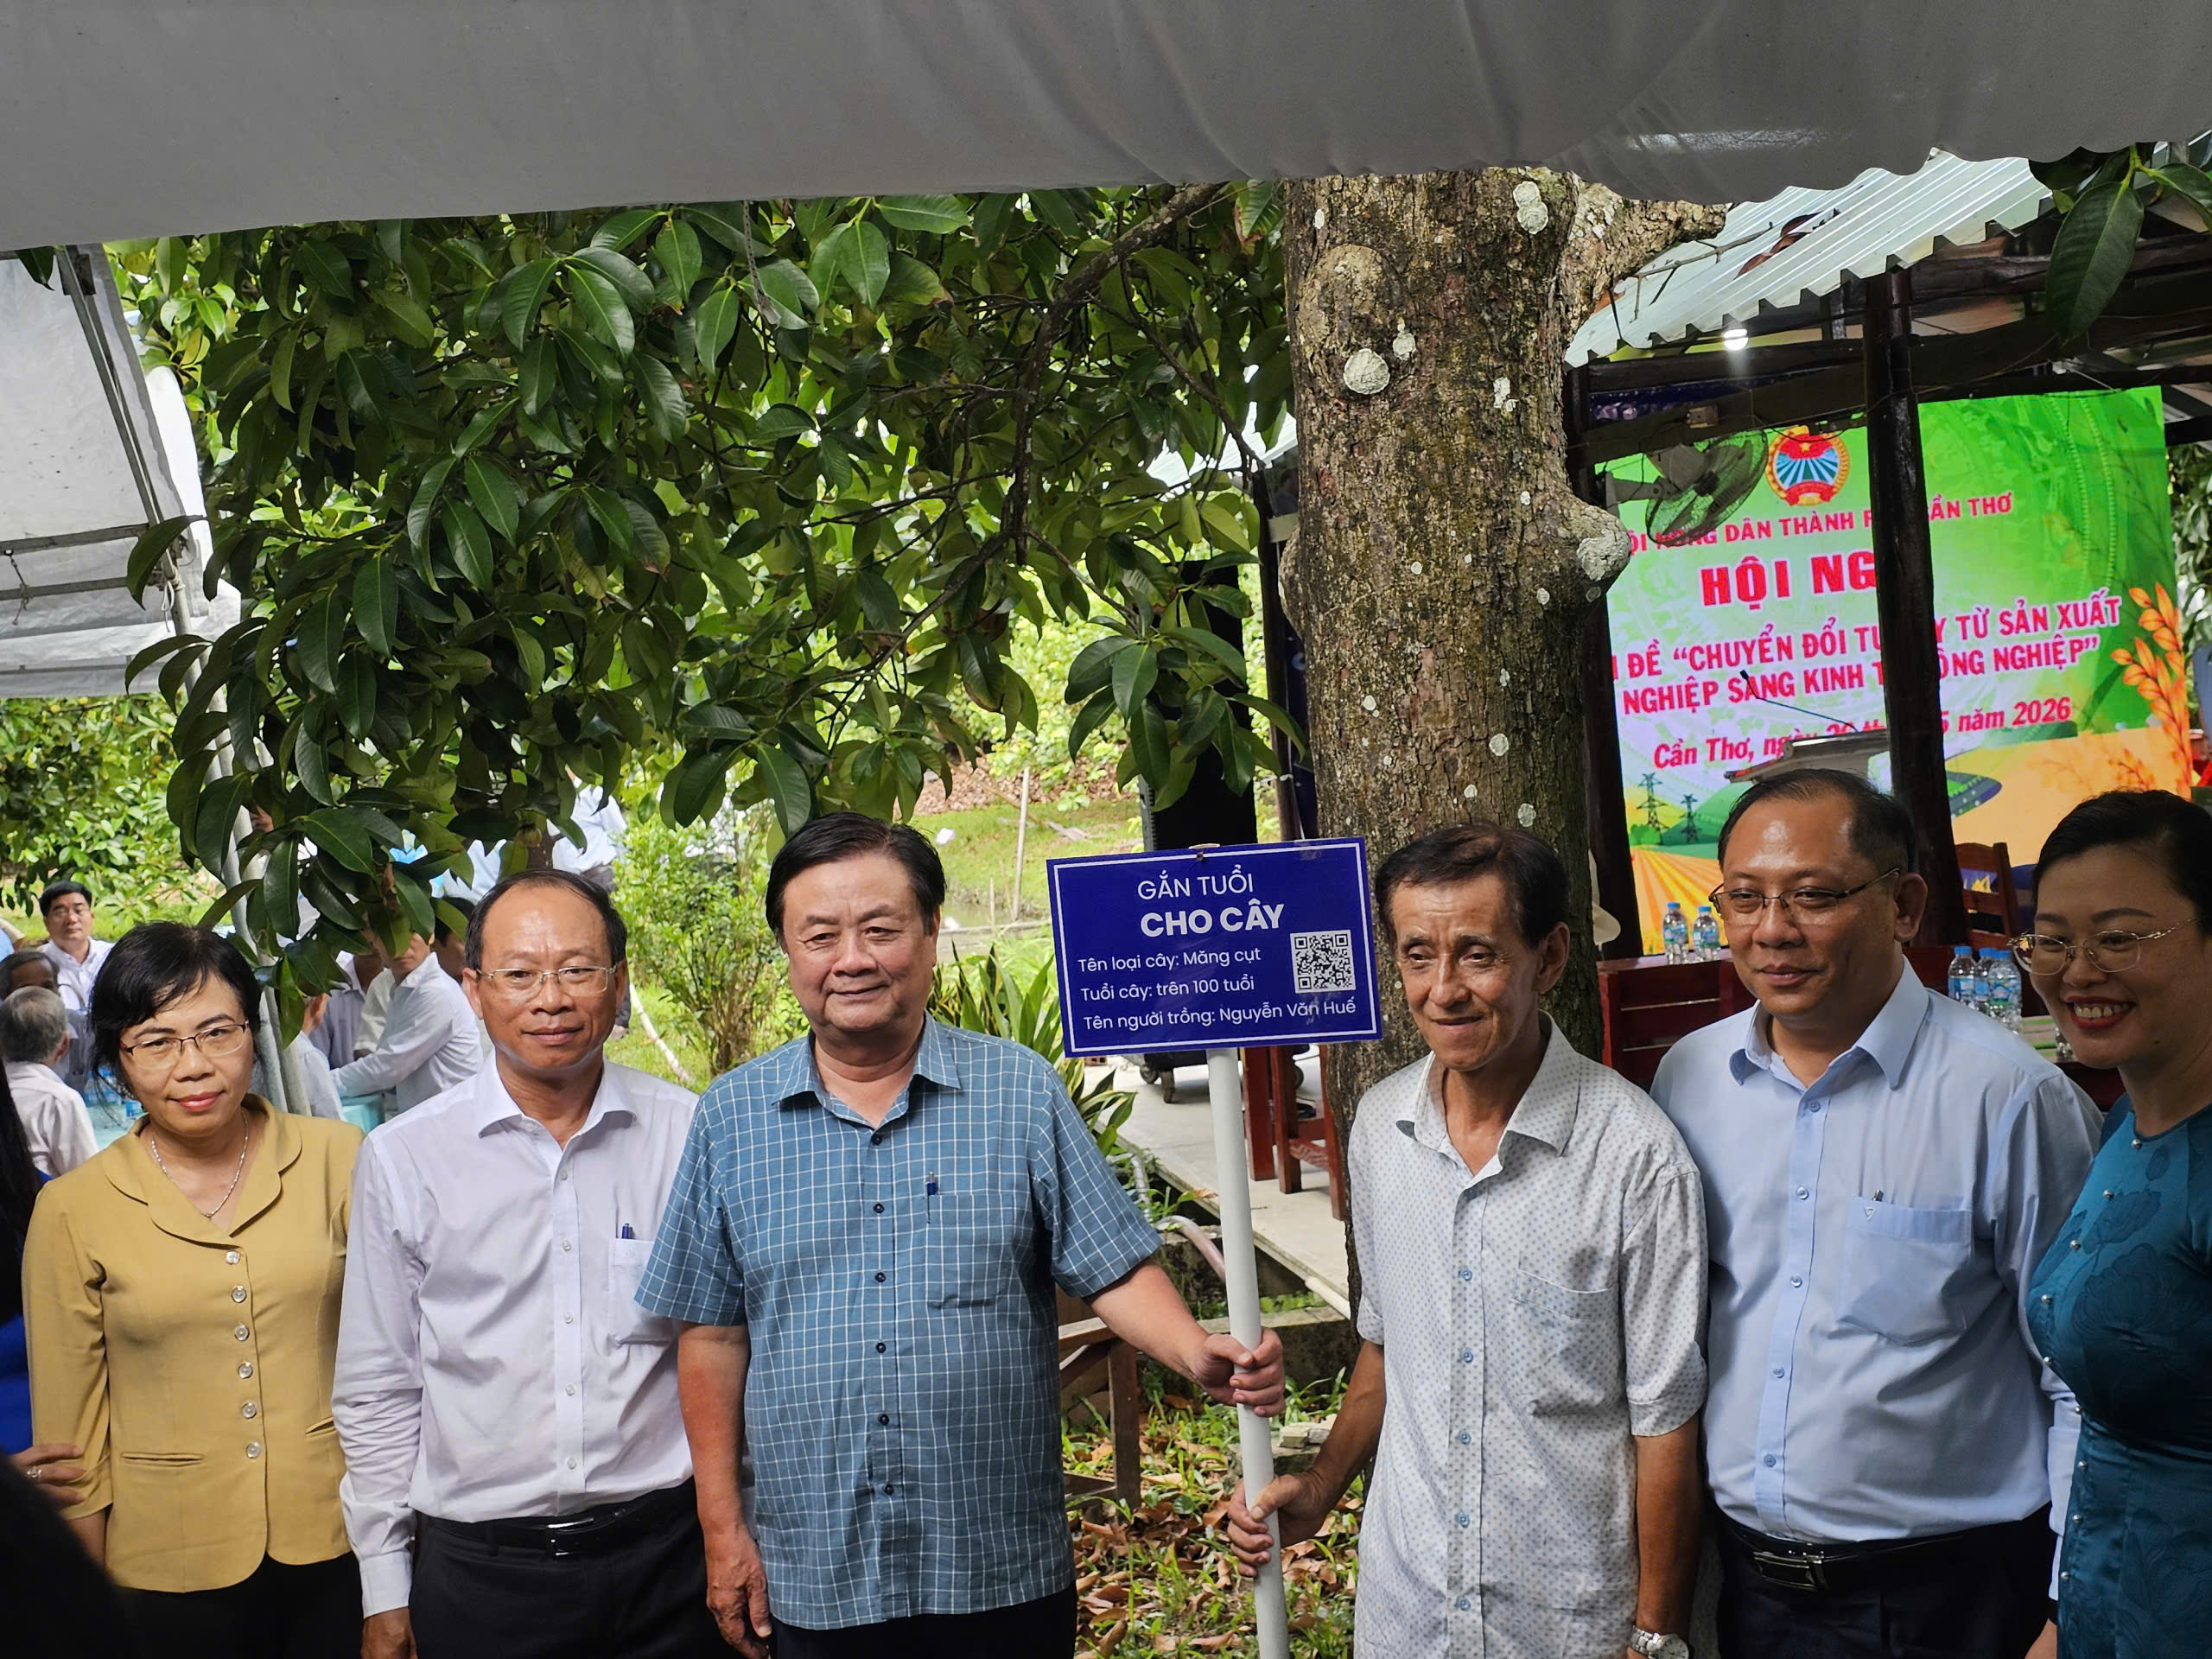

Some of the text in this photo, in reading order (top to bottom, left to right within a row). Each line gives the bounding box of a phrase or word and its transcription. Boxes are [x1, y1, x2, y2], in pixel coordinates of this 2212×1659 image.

[1725, 518, 1772, 543] DÂN
[1779, 512, 1854, 537] THÀNH
[1929, 495, 1961, 520] ẦN
[1968, 493, 2012, 516] THƠ
[1700, 550, 1877, 610] HỘI NG
[1626, 639, 1662, 678] ĐỀ
[1673, 623, 1794, 671] “CHUYỂN
[1802, 616, 1847, 658] ĐỔI
[1955, 608, 1989, 640] TỪ
[1999, 599, 2048, 636] SẢN
[2057, 590, 2120, 630] XUẤT
[1623, 676, 1719, 715] NGHIỆP
[1726, 671, 1796, 704] SANG
[1803, 664, 1865, 695] KINH
[1993, 634, 2098, 671] NGHIỆP”
[1653, 739, 1697, 769] Cần
[1706, 737, 1755, 762] Thơ,
[1957, 709, 2005, 733] năm
[2012, 696, 2072, 727] 2026
[1138, 865, 1253, 899] GẮN TUỔI
[1141, 899, 1284, 937] CHO CÂY
[1078, 948, 1261, 971] Tên loại cây: Măng cụt
[1081, 976, 1254, 1001] Tuổi cây: trên 100 tuổi
[1084, 996, 1356, 1031] Tên người trồng: Nguyễn Văn Huế
